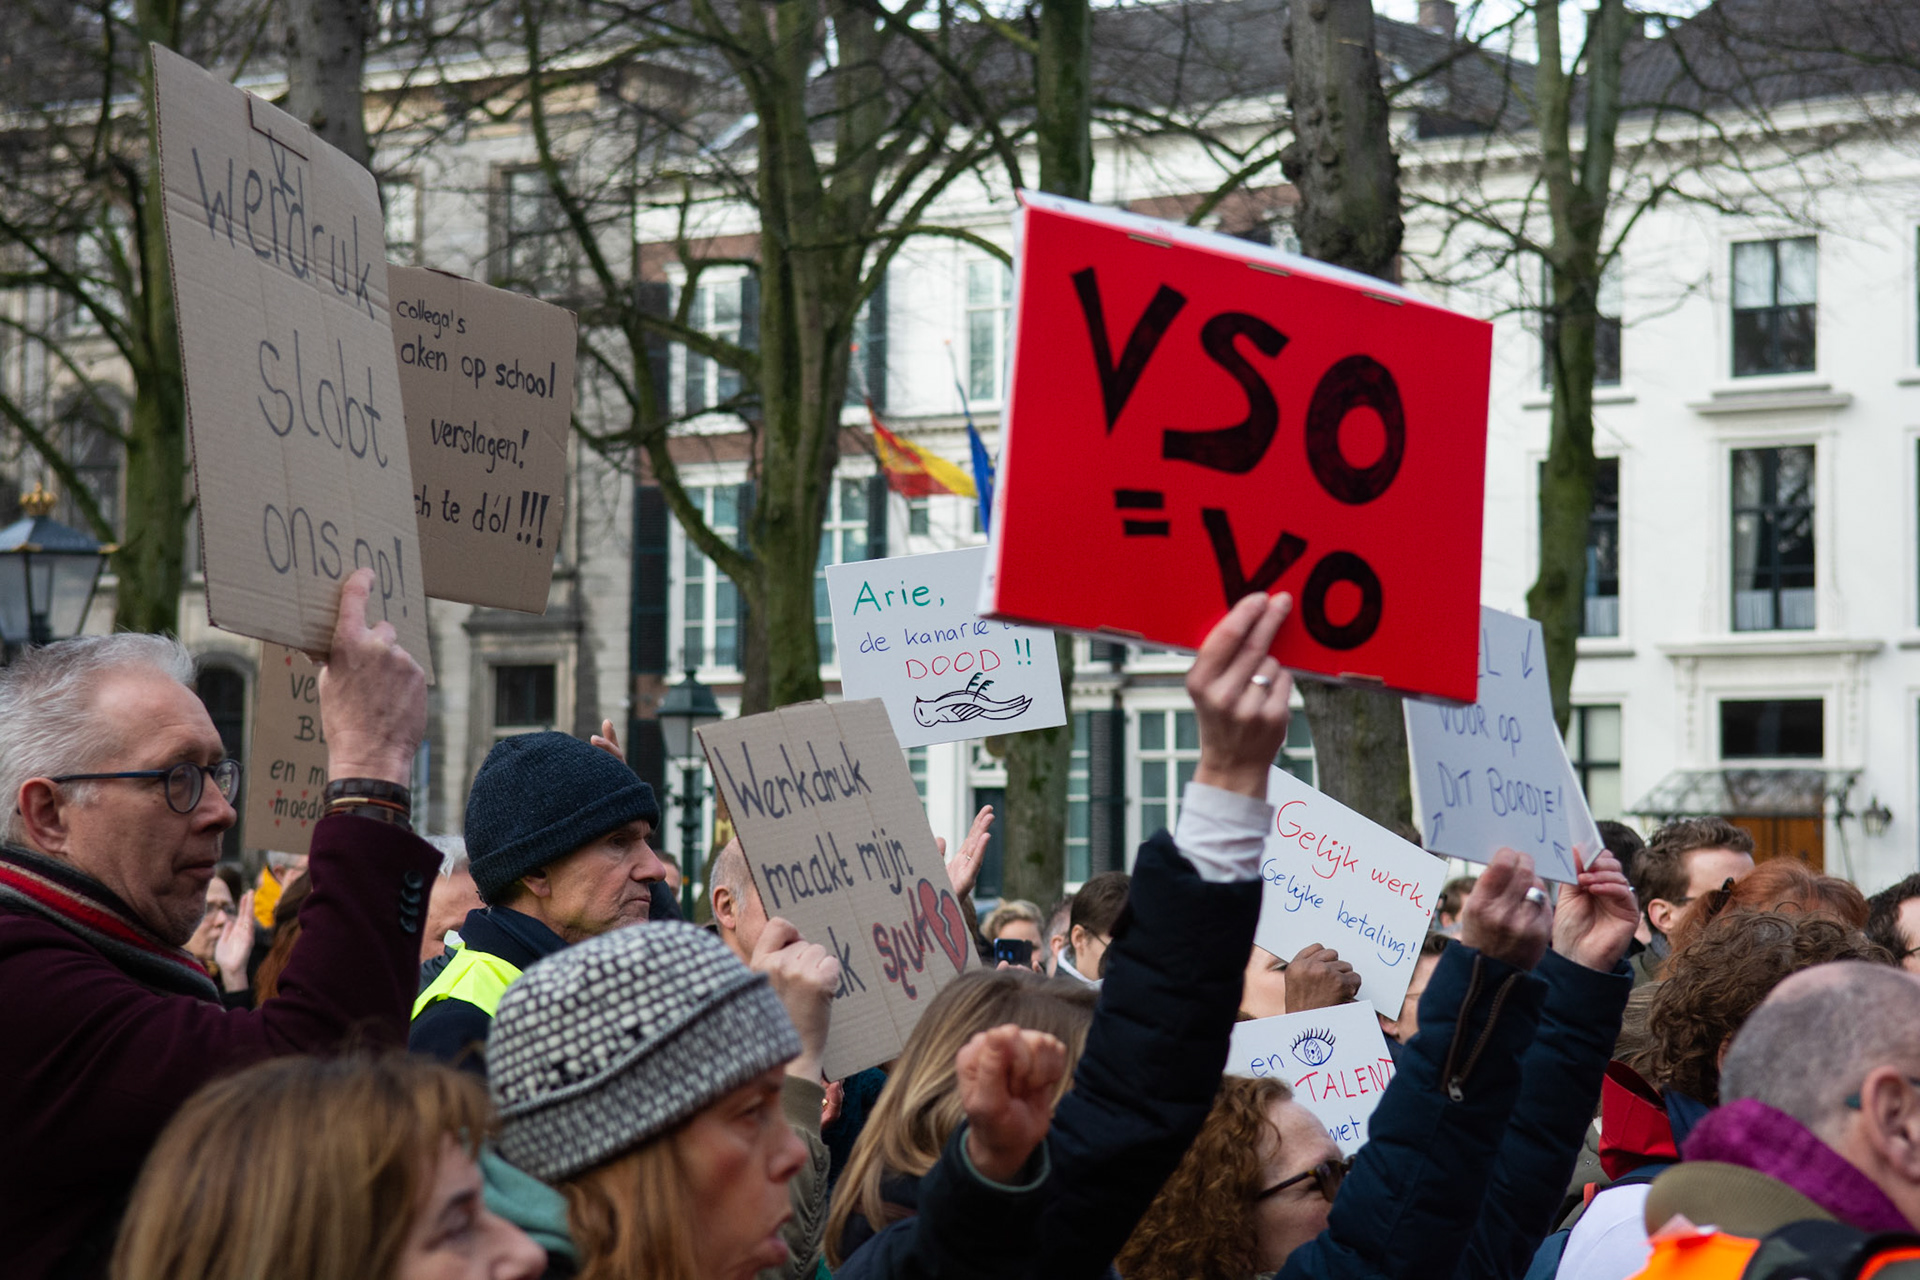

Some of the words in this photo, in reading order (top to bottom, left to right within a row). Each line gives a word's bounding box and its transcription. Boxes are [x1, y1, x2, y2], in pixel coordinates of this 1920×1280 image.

[451, 355, 486, 389] op
[495, 358, 556, 399] school
[1070, 266, 1406, 506] VSO
[442, 489, 460, 523] te
[853, 580, 945, 616] Arie,
[1202, 507, 1384, 651] VO
[859, 632, 891, 654] de
[904, 613, 990, 646] kanarie
[1499, 714, 1522, 758] op
[270, 758, 296, 783] en
[713, 740, 873, 819] Werkdruk
[761, 831, 855, 910] maakt
[855, 827, 914, 895] mijn
[1276, 800, 1359, 879] Gelijk
[1371, 868, 1431, 917] werk,
[1261, 858, 1324, 912] Gelijke
[1336, 900, 1416, 967] betaling!
[1250, 1053, 1285, 1078] en
